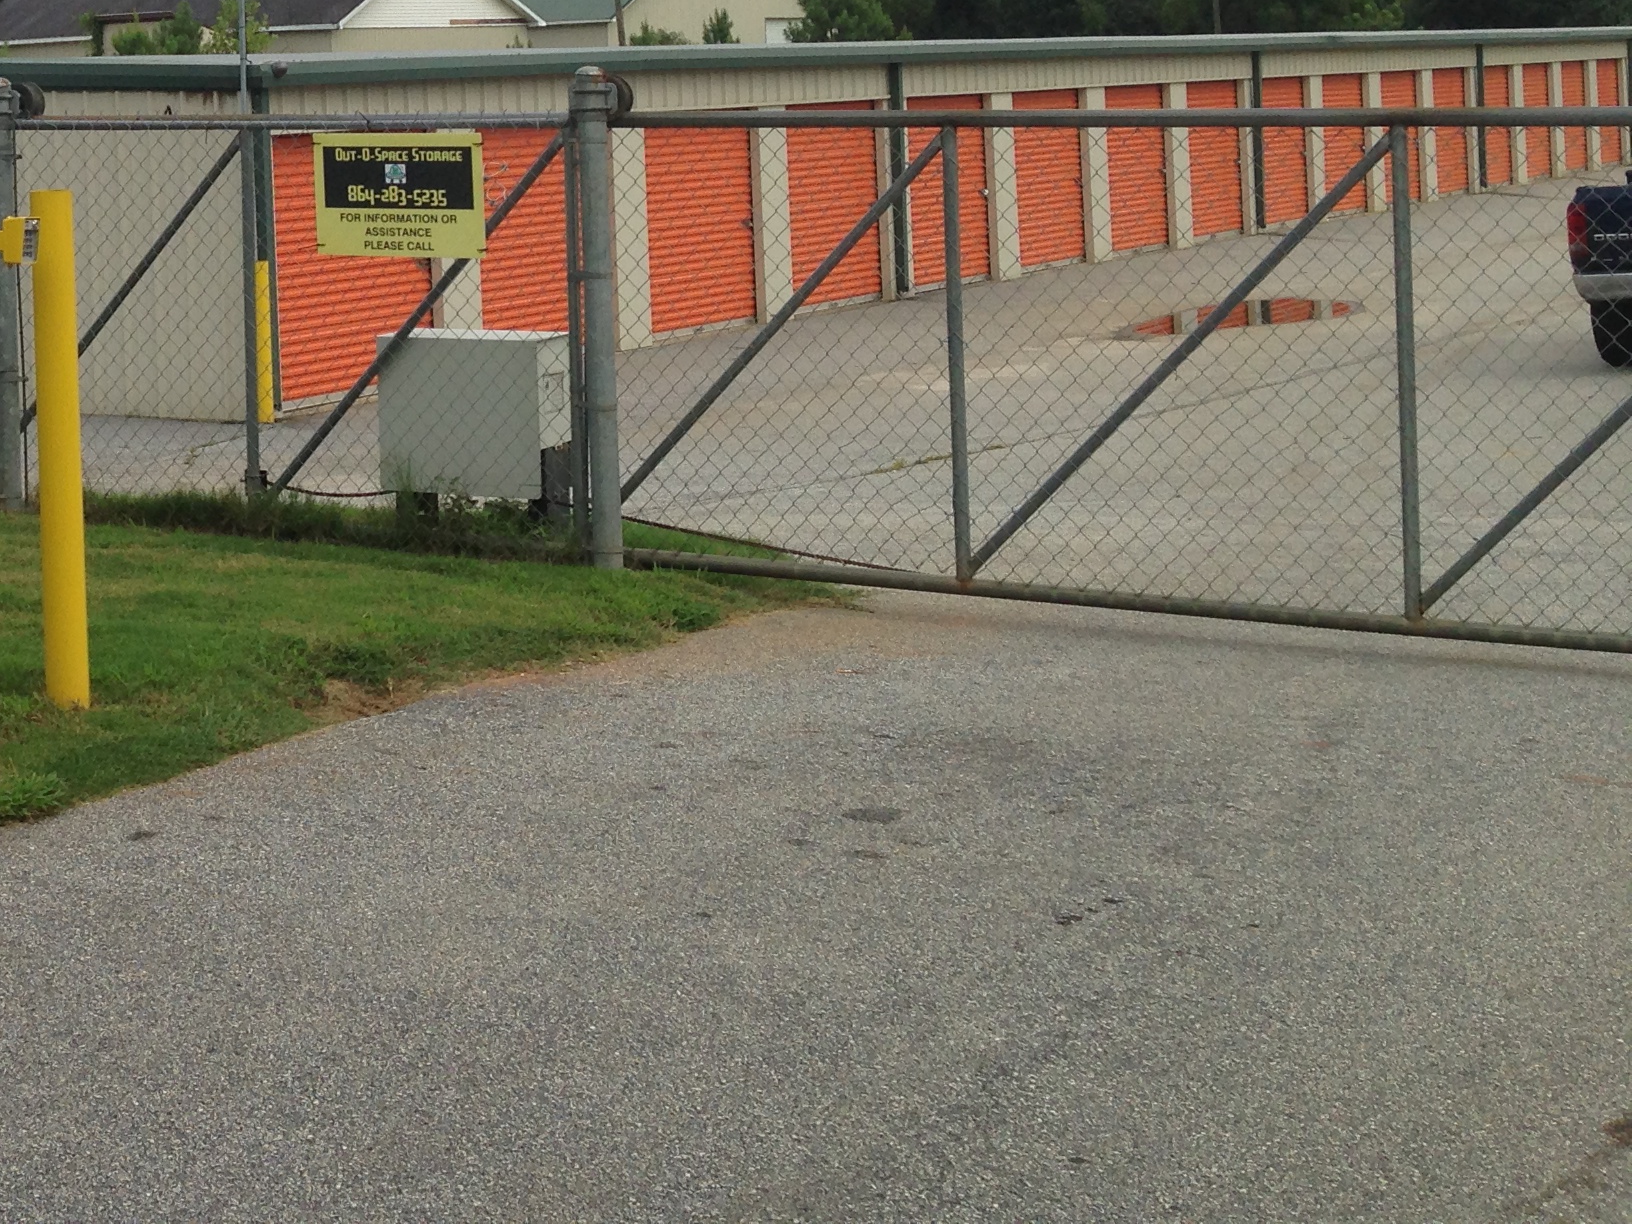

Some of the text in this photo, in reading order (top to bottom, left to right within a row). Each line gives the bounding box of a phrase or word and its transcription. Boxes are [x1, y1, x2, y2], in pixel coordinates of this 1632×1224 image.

[411, 148, 464, 163] STORAGE
[347, 184, 448, 207] 864-283-5235
[340, 212, 458, 224] FOR INFORMATION OR
[364, 226, 432, 238] ASSISTANCE
[363, 240, 435, 252] PLEASE CALL
